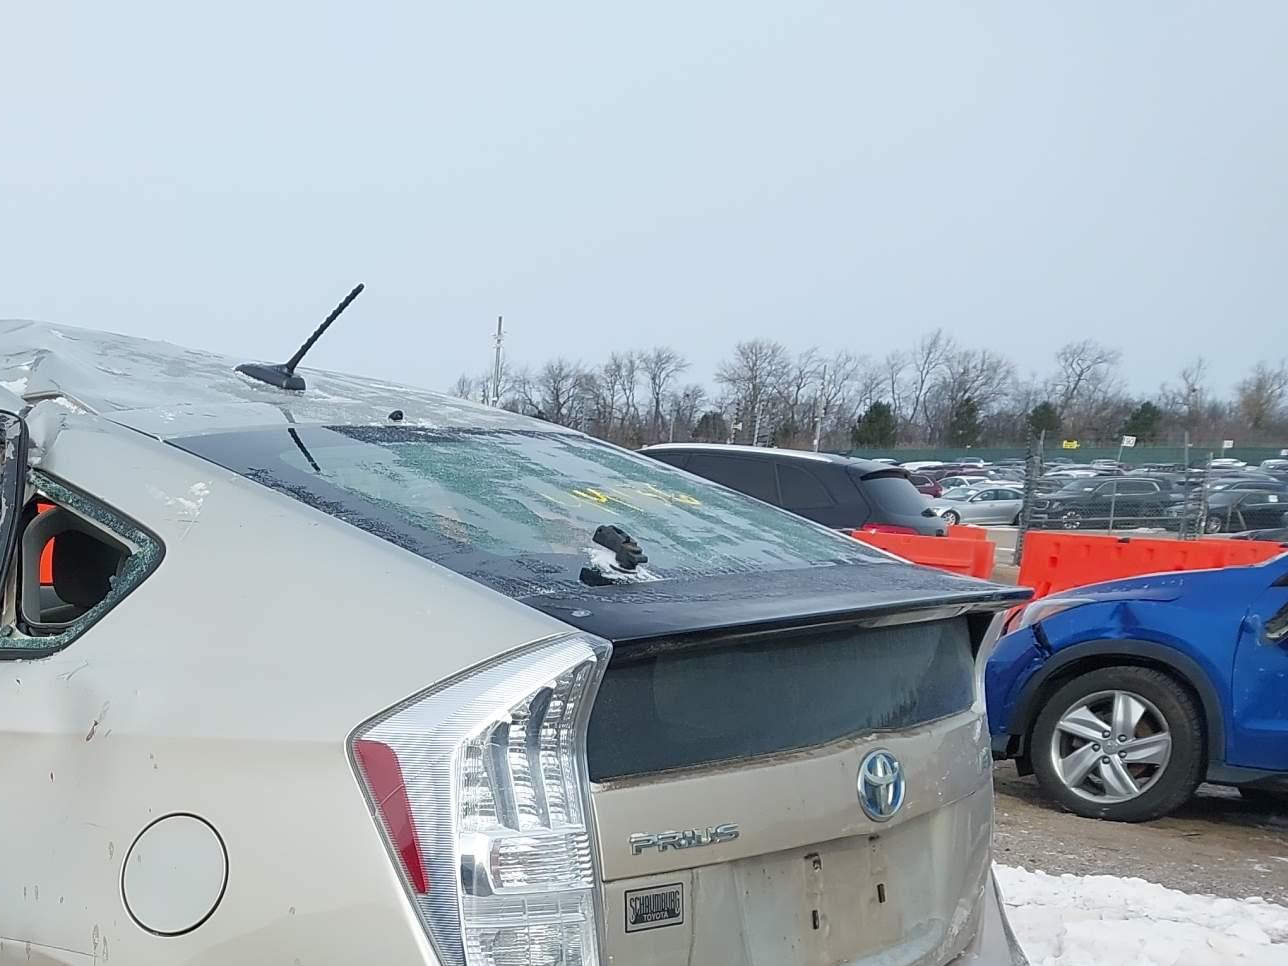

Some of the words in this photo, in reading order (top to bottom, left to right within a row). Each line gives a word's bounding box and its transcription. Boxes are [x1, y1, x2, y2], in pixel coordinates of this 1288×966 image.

[629, 822, 740, 856] PRIUS
[629, 890, 680, 922] SCHAUMBURG
[643, 911, 669, 922] TOYOTA
